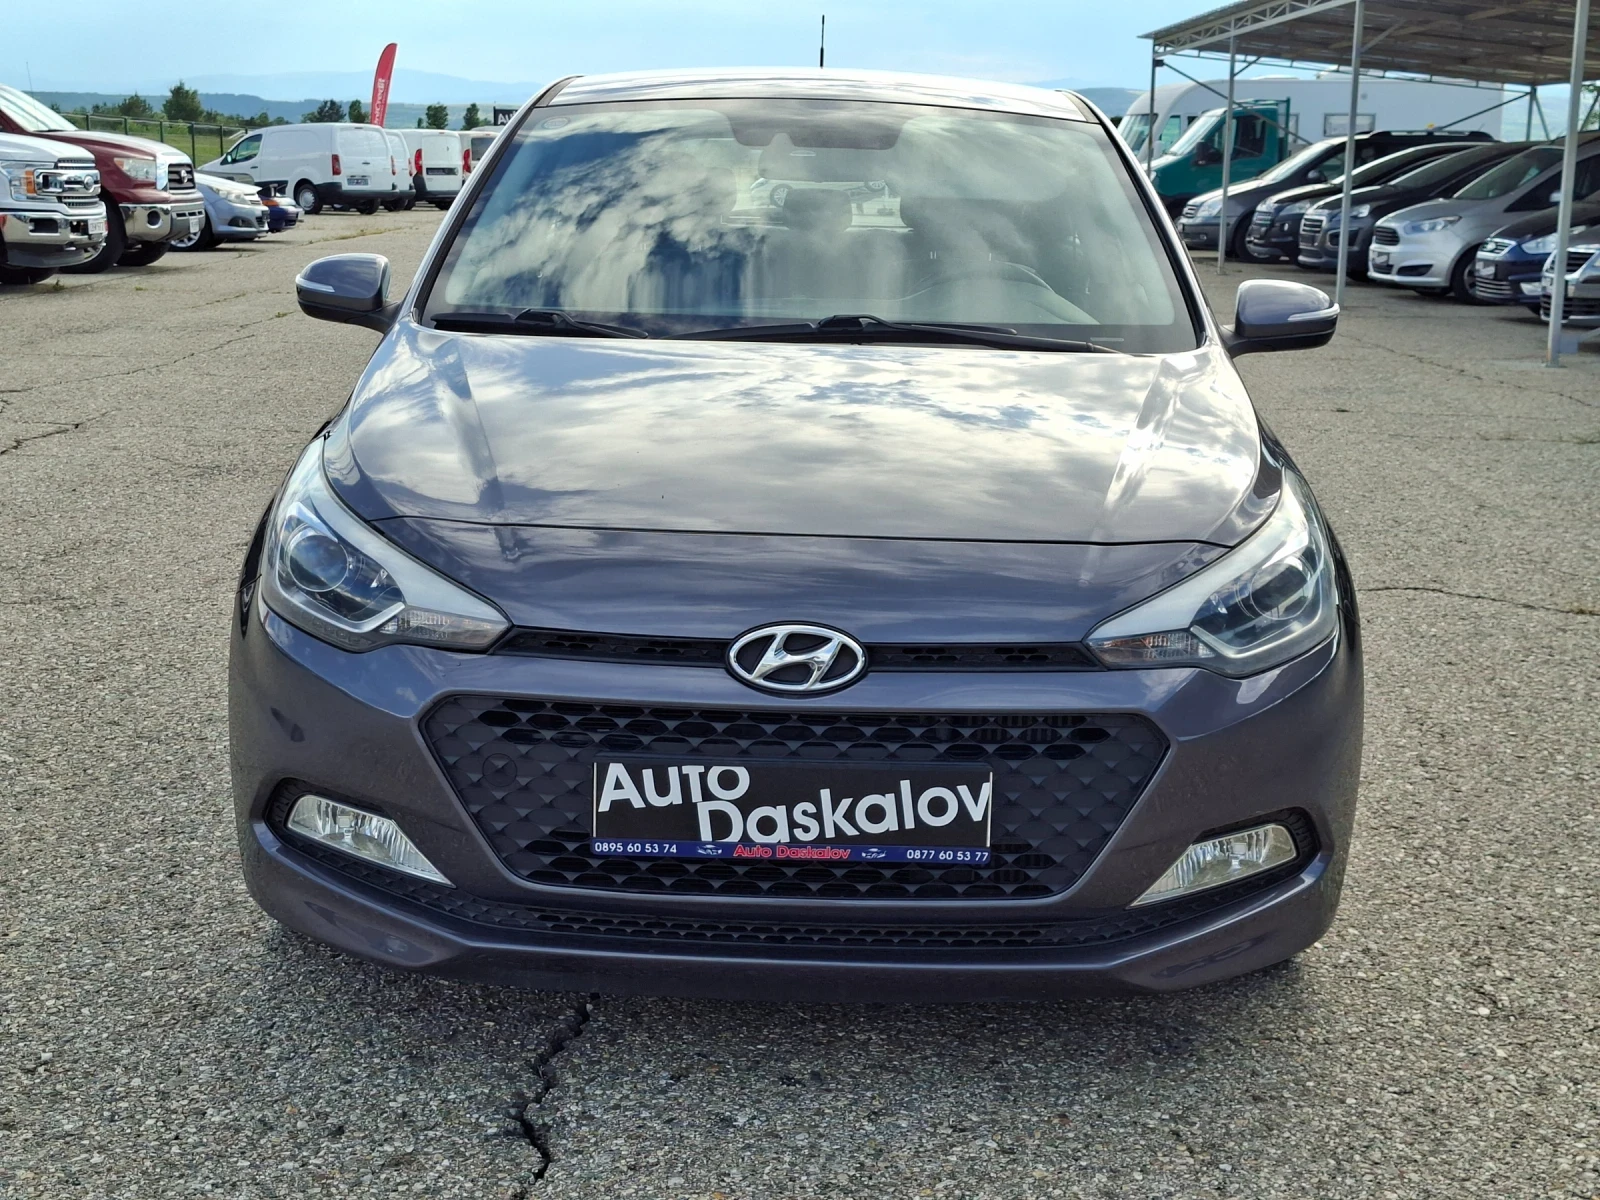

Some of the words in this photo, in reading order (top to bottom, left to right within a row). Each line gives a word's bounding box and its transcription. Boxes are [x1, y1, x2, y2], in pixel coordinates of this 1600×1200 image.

[696, 779, 991, 843] Daskalov
[594, 842, 624, 852] 0895
[626, 842, 642, 853] 60
[644, 843, 659, 853] 53
[663, 843, 677, 854] 74
[732, 844, 773, 858] Auto
[776, 845, 852, 860] Daskalov
[906, 849, 935, 860] 0877
[938, 850, 953, 860] 60
[956, 851, 971, 861] 53
[975, 851, 989, 861] 77
